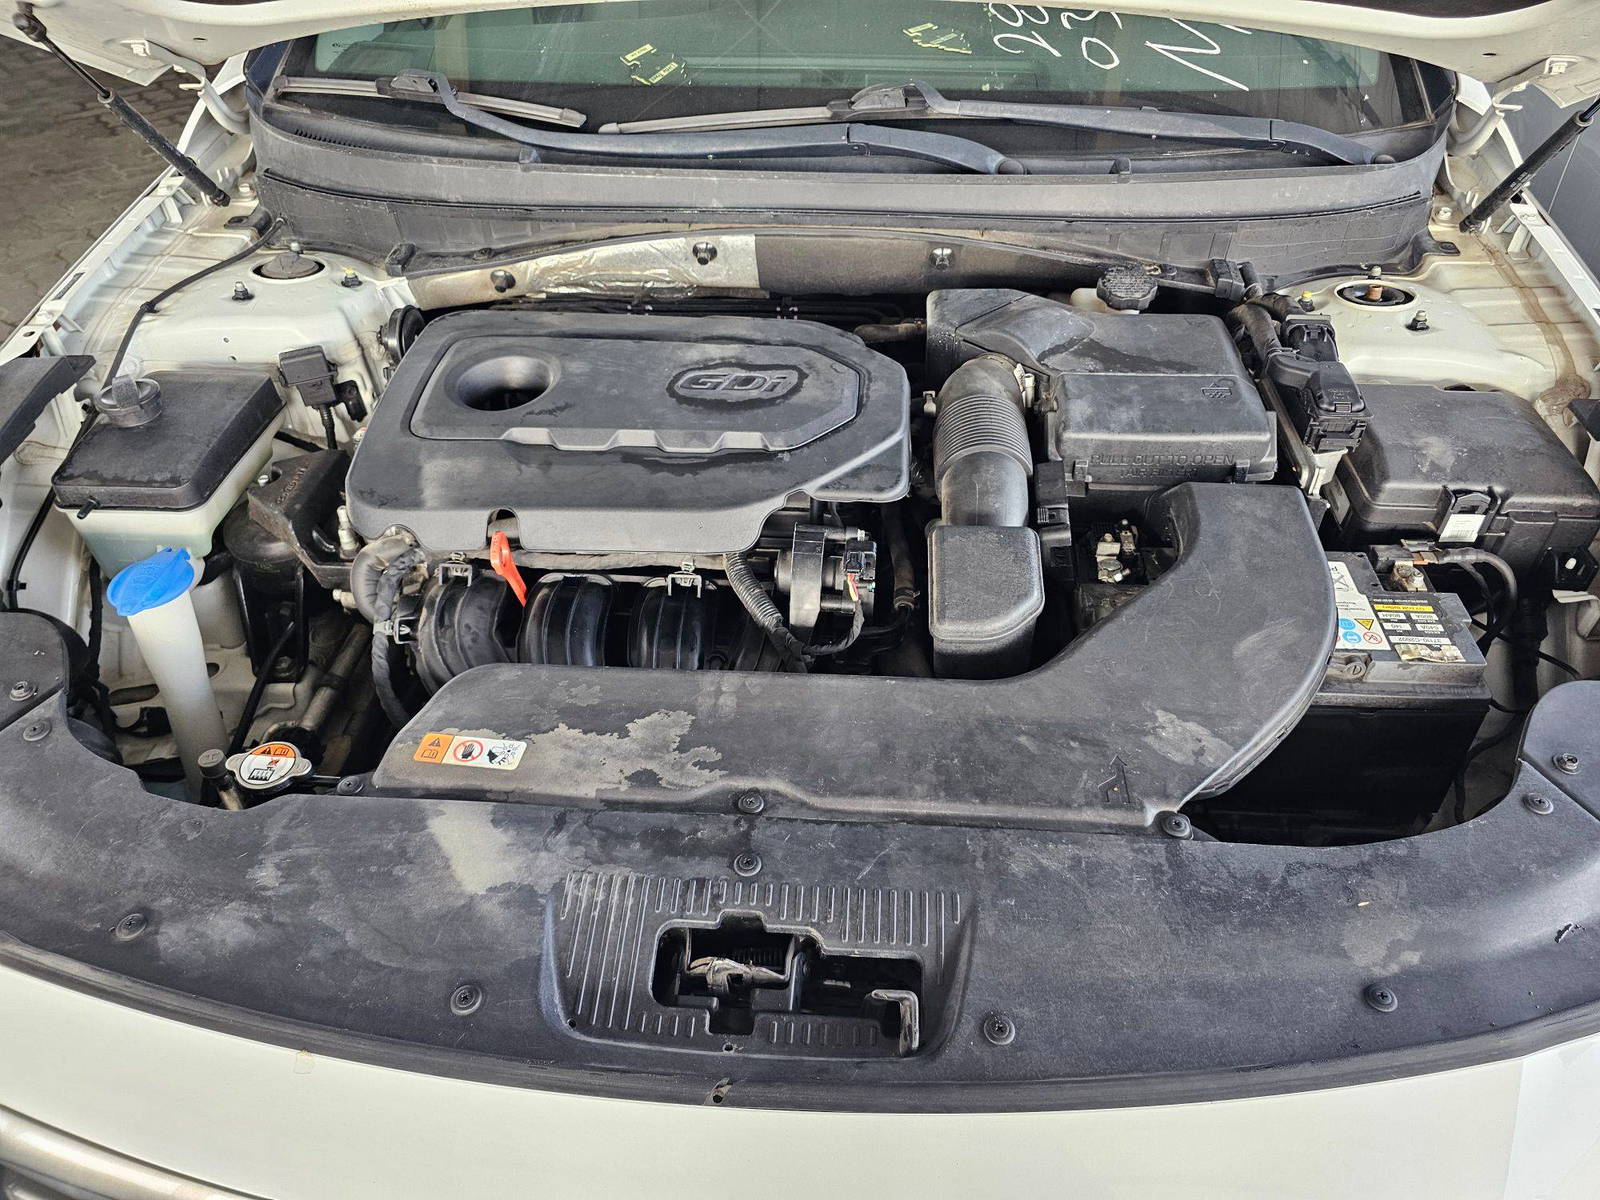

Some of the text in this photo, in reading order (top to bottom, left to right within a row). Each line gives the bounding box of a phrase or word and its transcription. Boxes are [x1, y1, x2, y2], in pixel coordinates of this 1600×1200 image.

[679, 372, 788, 392] GDi
[1090, 454, 1129, 466] PULL
[1191, 454, 1235, 466] OPEN
